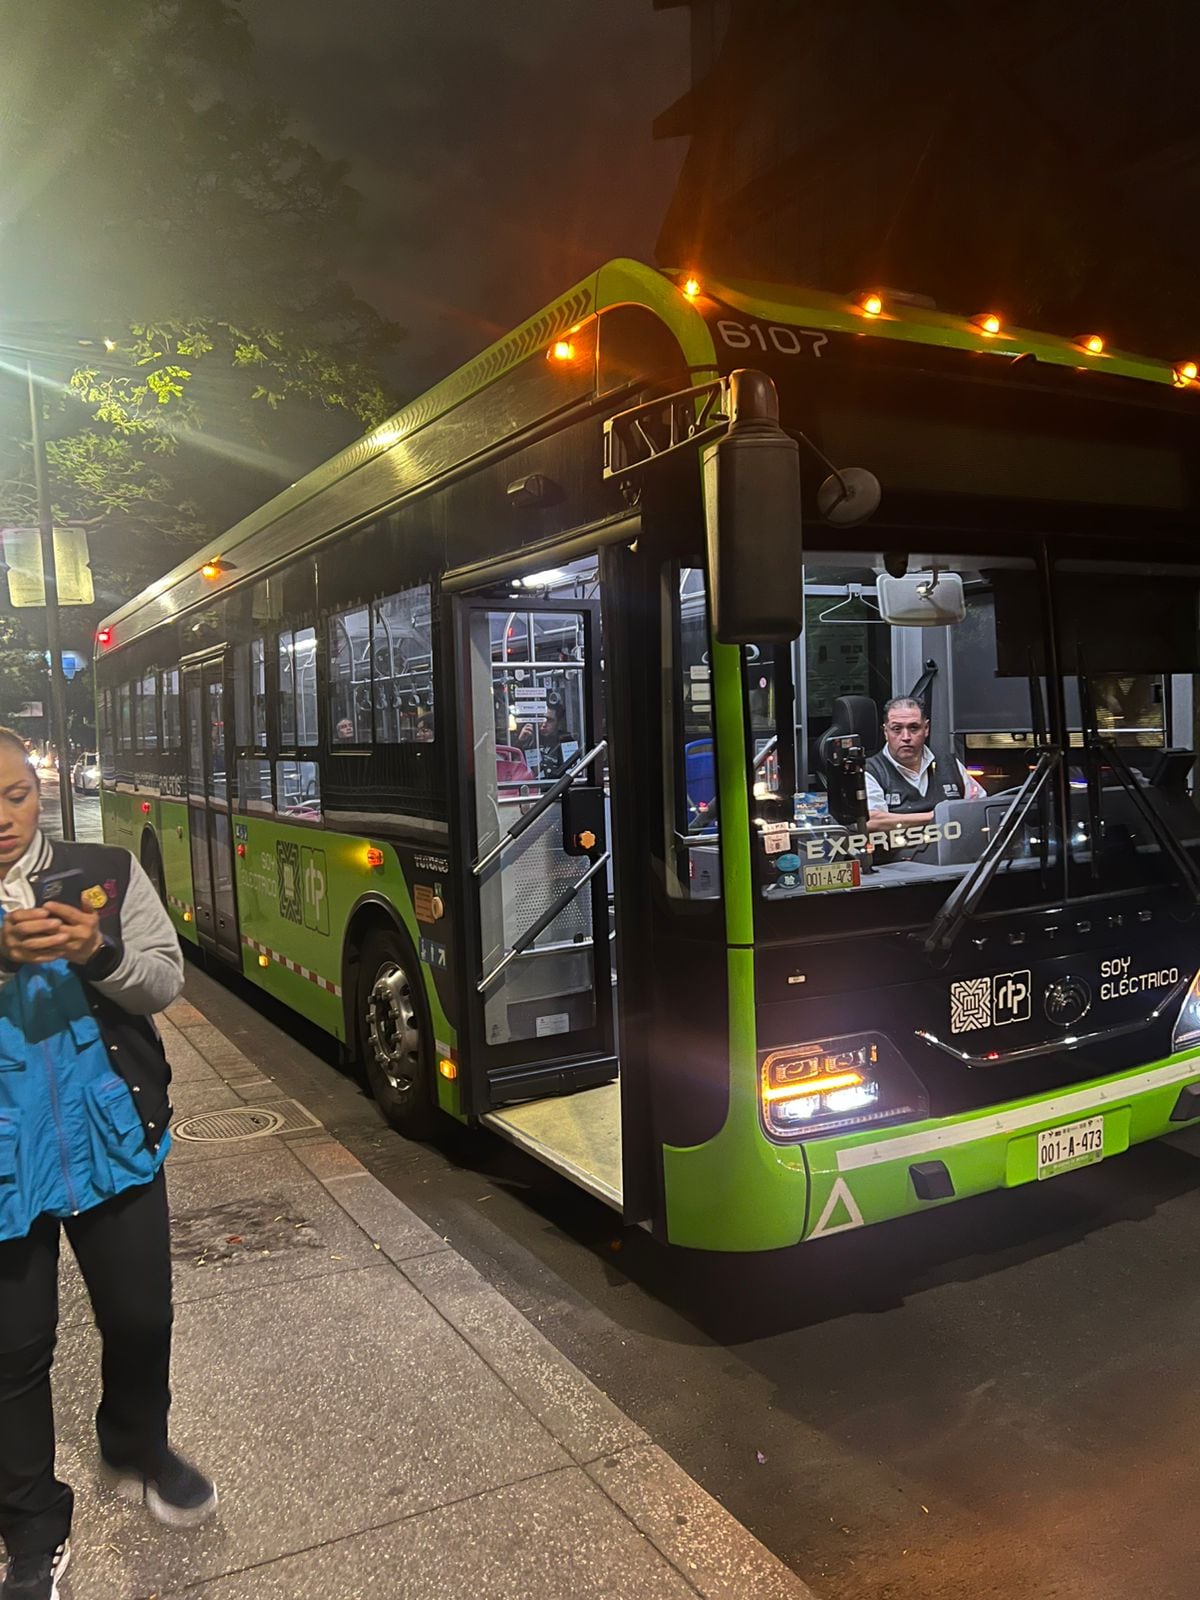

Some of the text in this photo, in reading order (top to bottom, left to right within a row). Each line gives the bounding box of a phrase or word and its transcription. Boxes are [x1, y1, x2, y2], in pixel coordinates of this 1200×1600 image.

[717, 320, 828, 357] 6107
[806, 821, 962, 860] EXPRESSO
[806, 869, 853, 887] 001-A-473
[1100, 956, 1131, 978] SOY
[1100, 967, 1179, 1000] ELÉCTRICO
[1041, 1129, 1102, 1164] 001-A-473
